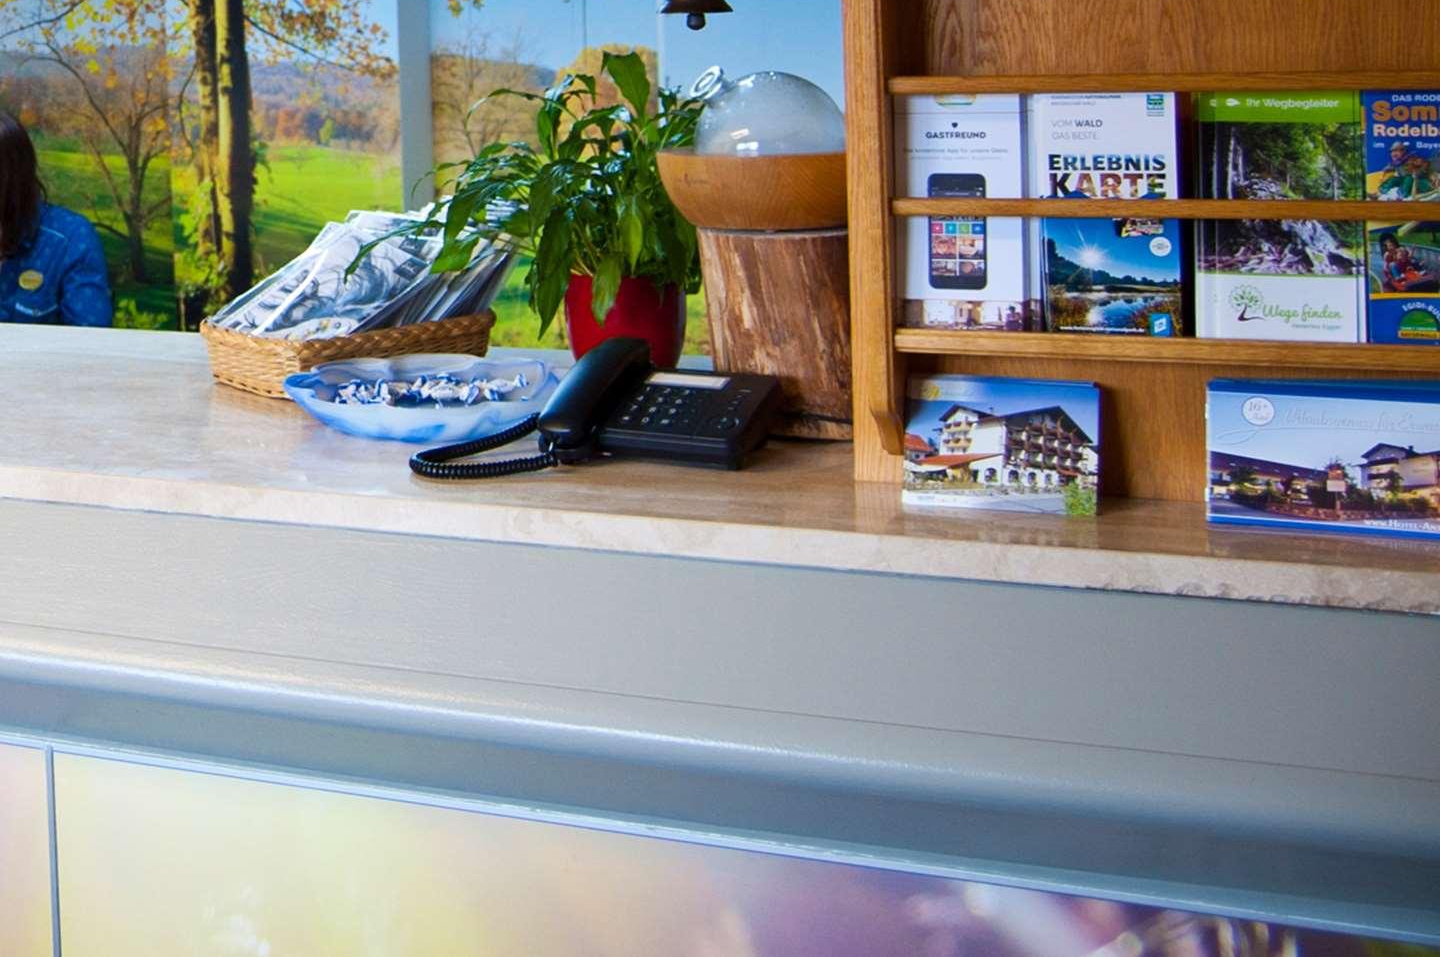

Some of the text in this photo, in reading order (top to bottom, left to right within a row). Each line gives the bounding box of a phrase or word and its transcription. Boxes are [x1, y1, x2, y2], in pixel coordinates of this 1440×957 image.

[1262, 97, 1339, 111] Wegbegleiter
[1391, 94, 1413, 103] DAS
[1372, 100, 1440, 123] Som
[1074, 119, 1104, 128] WALD
[1372, 123, 1440, 138] Rodelb
[925, 130, 987, 140] GASTFREUND
[1416, 141, 1440, 150] Baye
[1048, 153, 1166, 171] ERLEBNIS
[1048, 173, 1167, 199] KARTE
[1262, 303, 1344, 324] Wege finden
